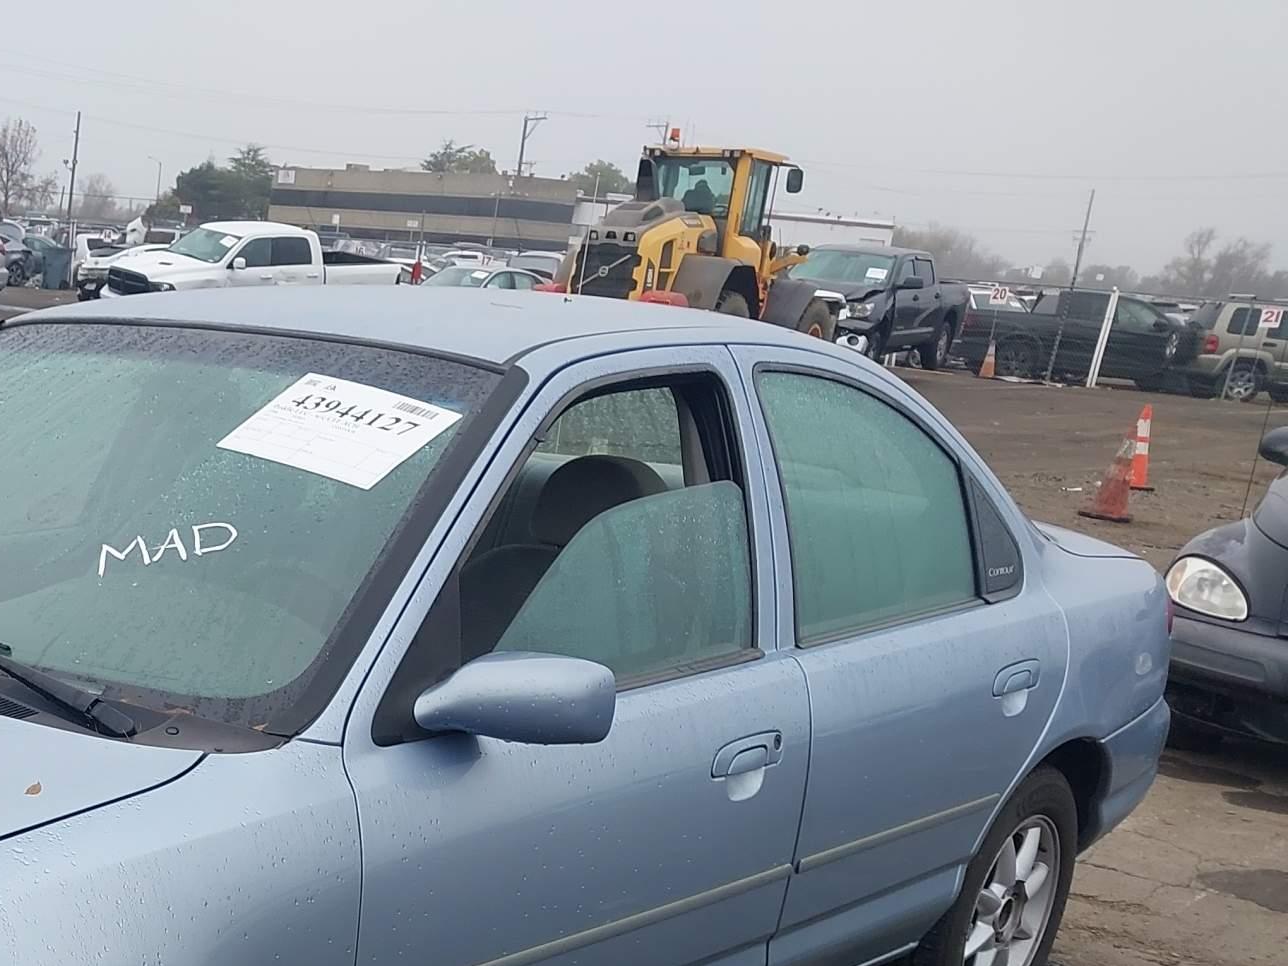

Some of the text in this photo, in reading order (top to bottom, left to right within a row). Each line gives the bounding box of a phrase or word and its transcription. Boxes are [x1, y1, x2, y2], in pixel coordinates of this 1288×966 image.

[482, 255, 491, 265] 17
[991, 287, 1008, 300] 20
[1263, 310, 1281, 323] 21
[291, 394, 422, 436] 43944127
[98, 522, 238, 578] MAD
